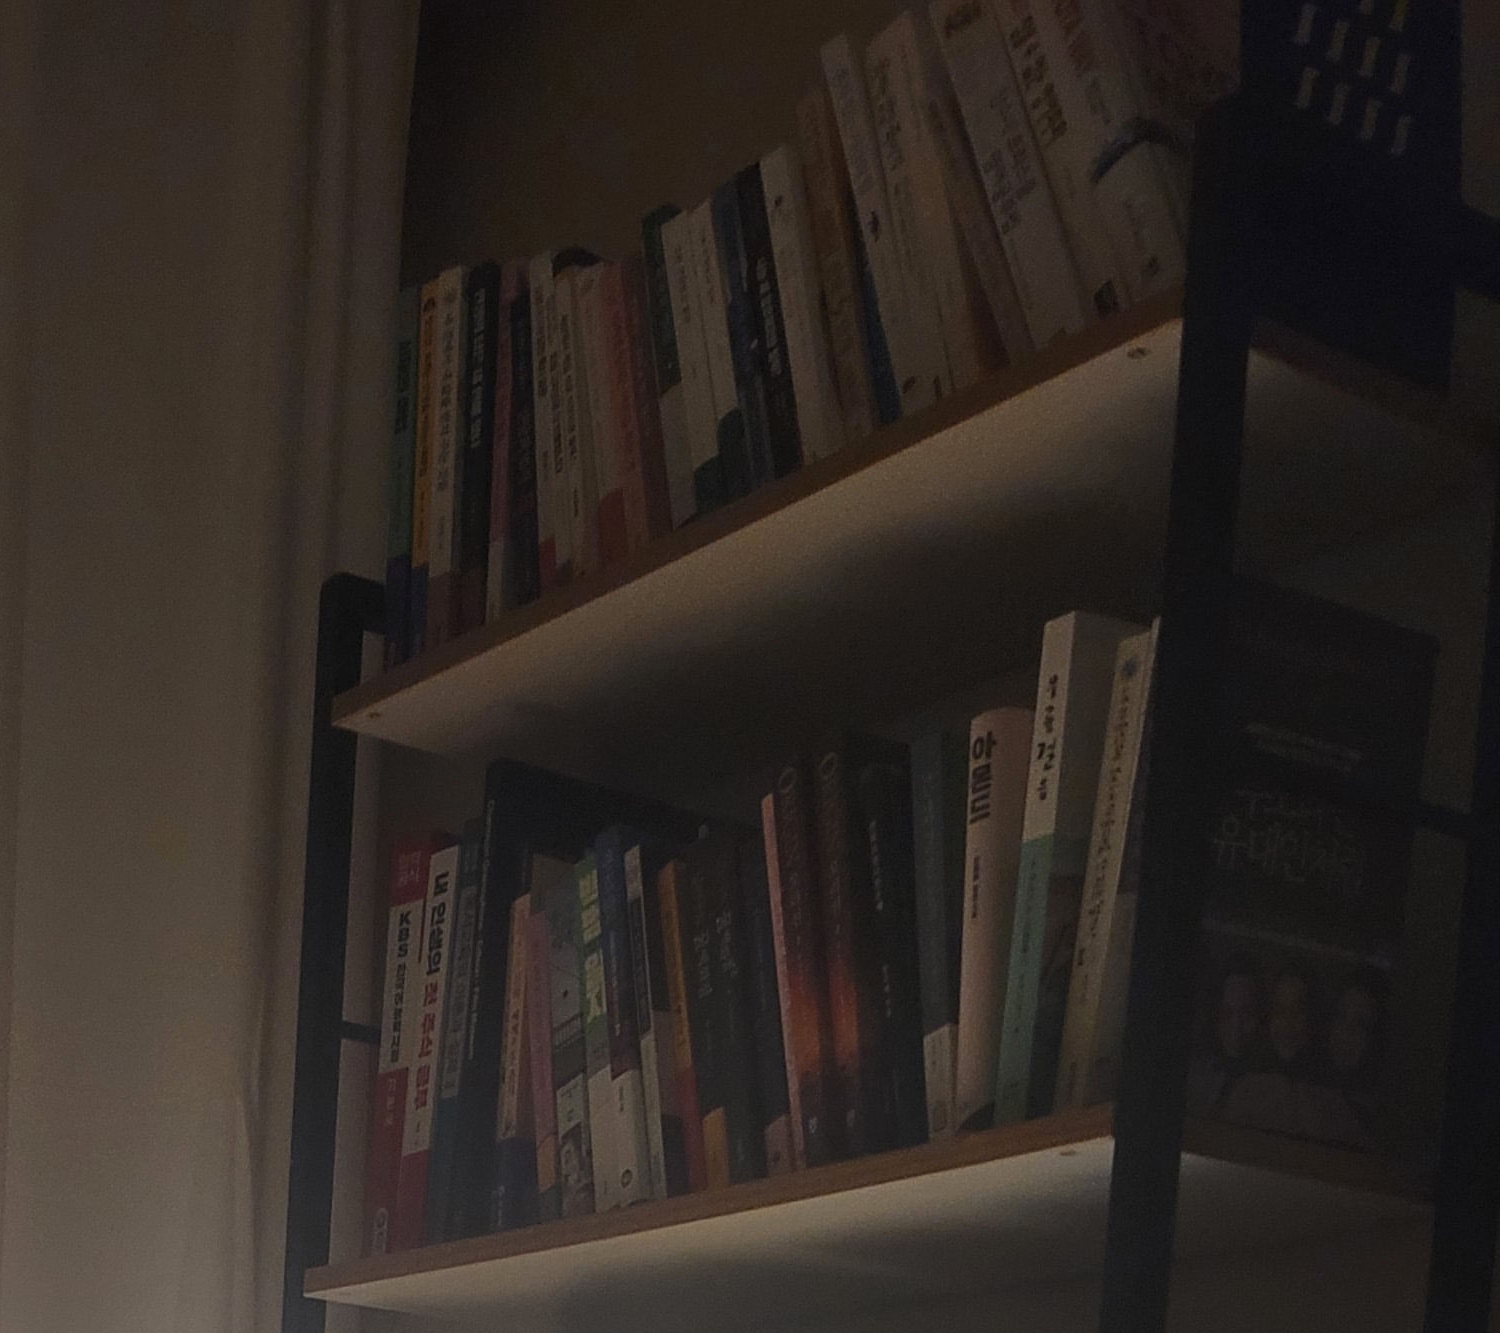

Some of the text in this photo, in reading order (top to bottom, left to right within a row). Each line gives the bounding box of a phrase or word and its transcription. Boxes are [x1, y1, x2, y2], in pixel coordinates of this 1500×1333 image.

[968, 731, 997, 825] 아몬드
[397, 910, 412, 958] KBS
[414, 871, 450, 1111] 내 인생의 첫 주식 공부
